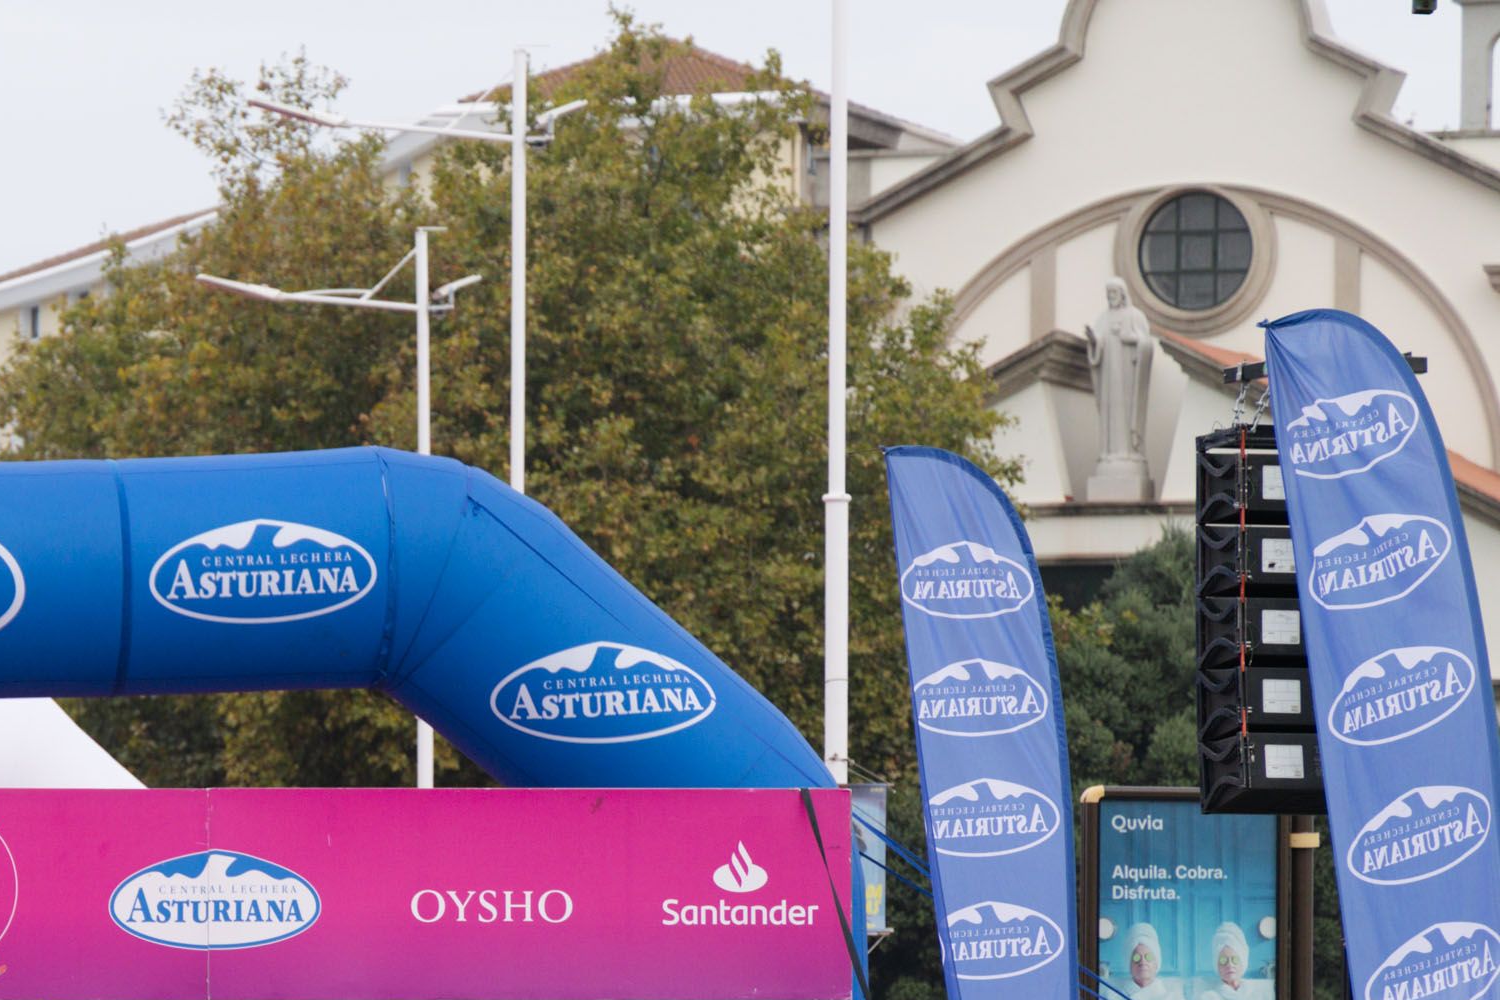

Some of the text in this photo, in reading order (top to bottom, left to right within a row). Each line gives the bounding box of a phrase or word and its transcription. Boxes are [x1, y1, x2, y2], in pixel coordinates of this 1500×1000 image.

[202, 551, 352, 567] CENTRAL LECHERA
[166, 559, 359, 600] ASTURIANA
[543, 673, 691, 690] CENTRAL LECHERA
[509, 683, 704, 720] ASTURIANA
[1111, 815, 1163, 832] Quvia
[1112, 865, 1228, 882] Alquila. Cobra.
[158, 884, 298, 895] CENTRAL LECHERA
[1112, 884, 1181, 900] Disfruta.
[126, 887, 305, 924] ASTURIANA
[410, 889, 573, 924] OYSHO
[661, 898, 819, 926] Santander
